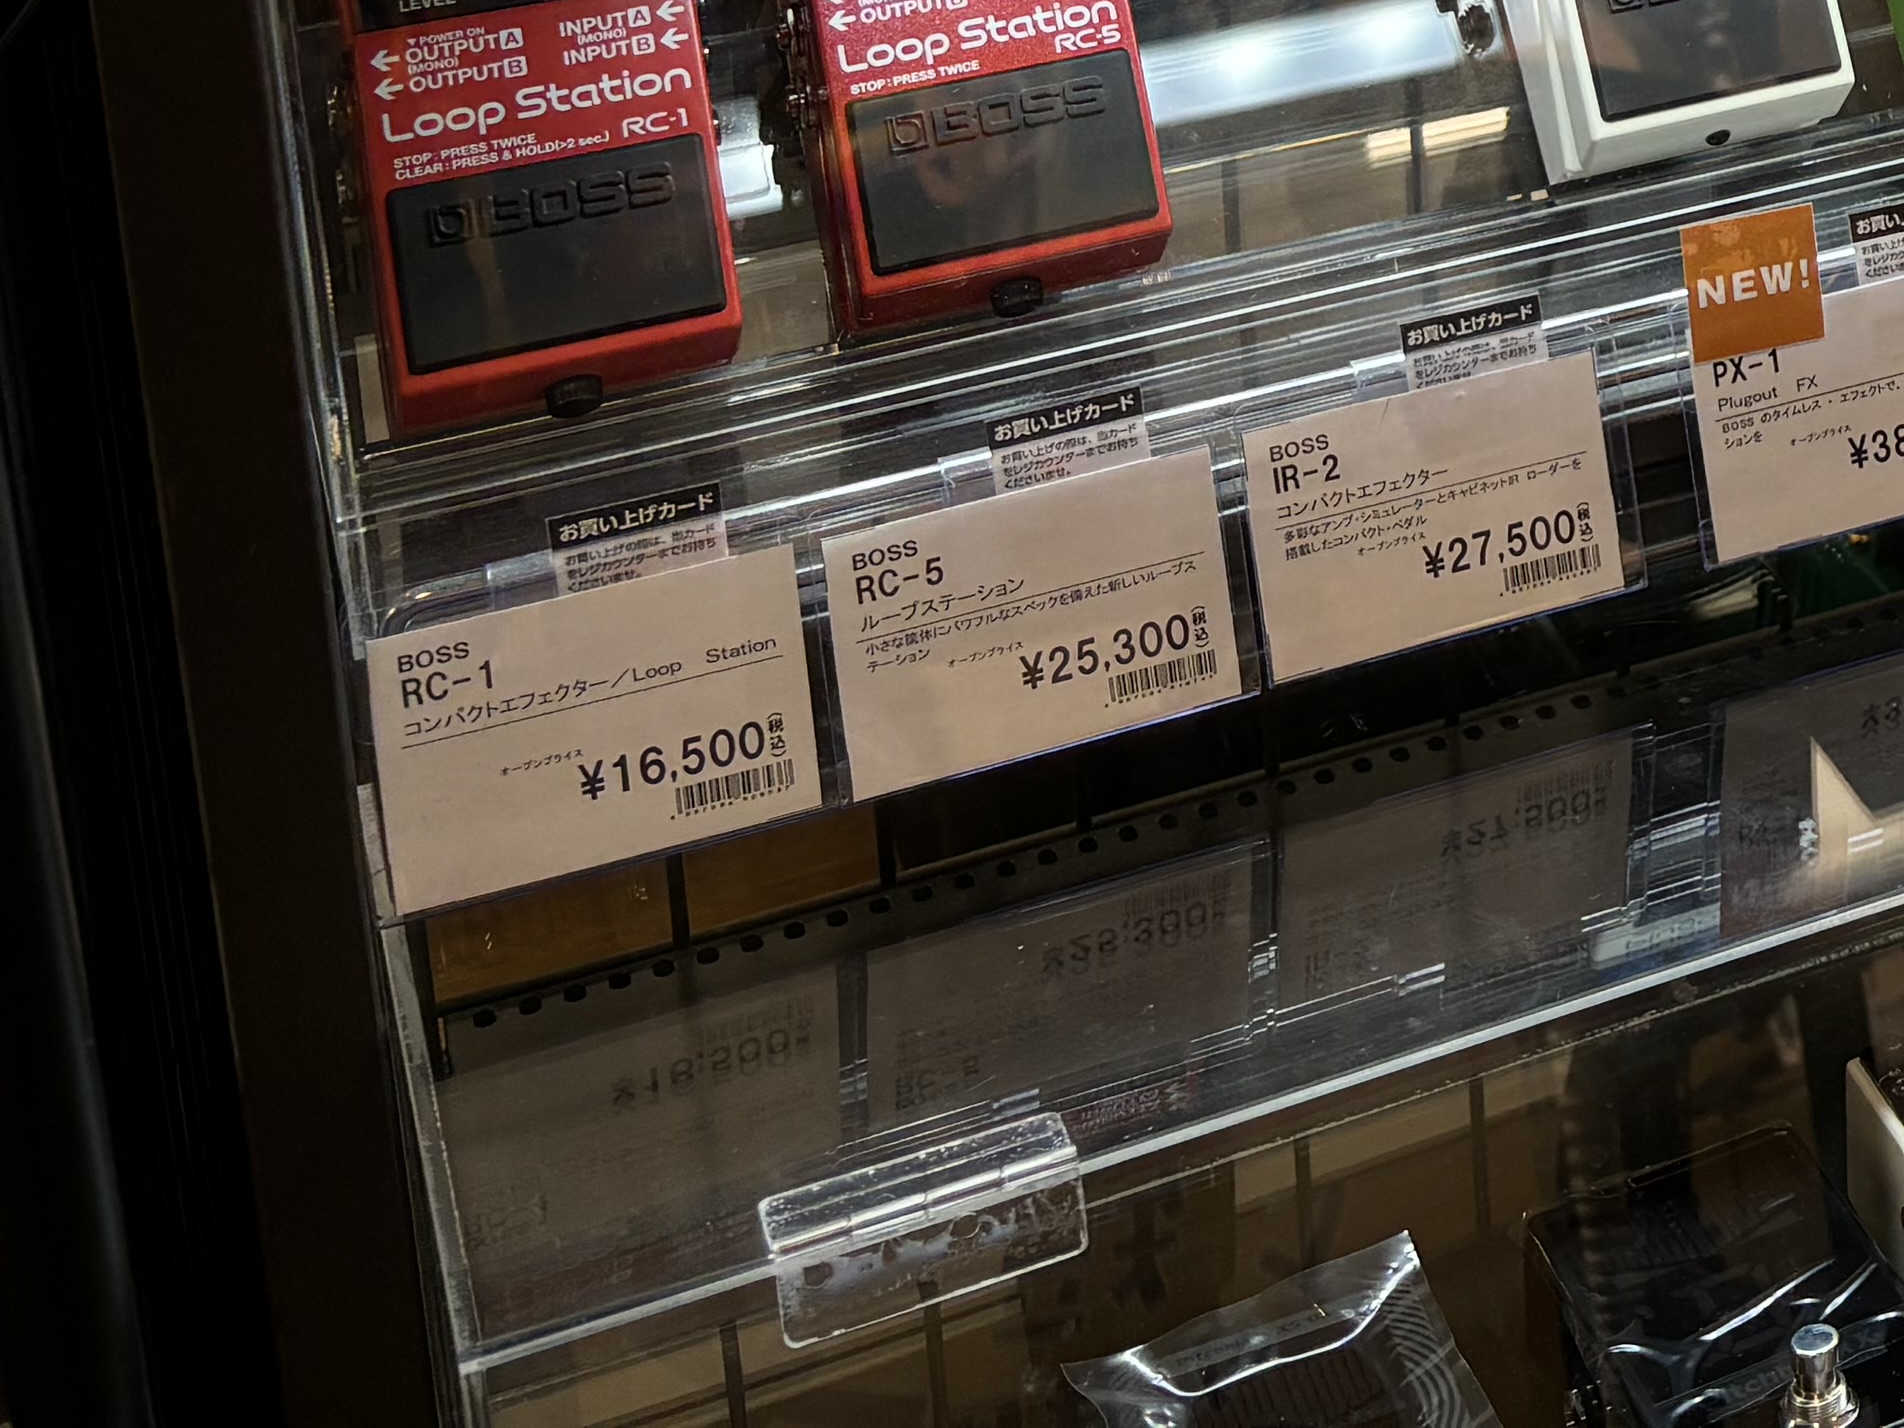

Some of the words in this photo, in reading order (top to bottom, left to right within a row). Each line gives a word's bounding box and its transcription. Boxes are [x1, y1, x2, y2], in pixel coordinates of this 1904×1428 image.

[838, 31, 950, 77] Loop
[960, 0, 1118, 49] Station
[1054, 27, 1121, 52] RC-5
[381, 101, 508, 144] Loop
[516, 68, 692, 123] Station
[622, 109, 689, 136] RC-1
[1697, 261, 1811, 308] NEW!
[1273, 455, 1341, 494] IR-2
[861, 575, 1025, 632] ループステーション
[1020, 612, 1190, 690] ¥25,300
[402, 661, 495, 708] RC-1
[580, 722, 765, 801] ¥16,500
